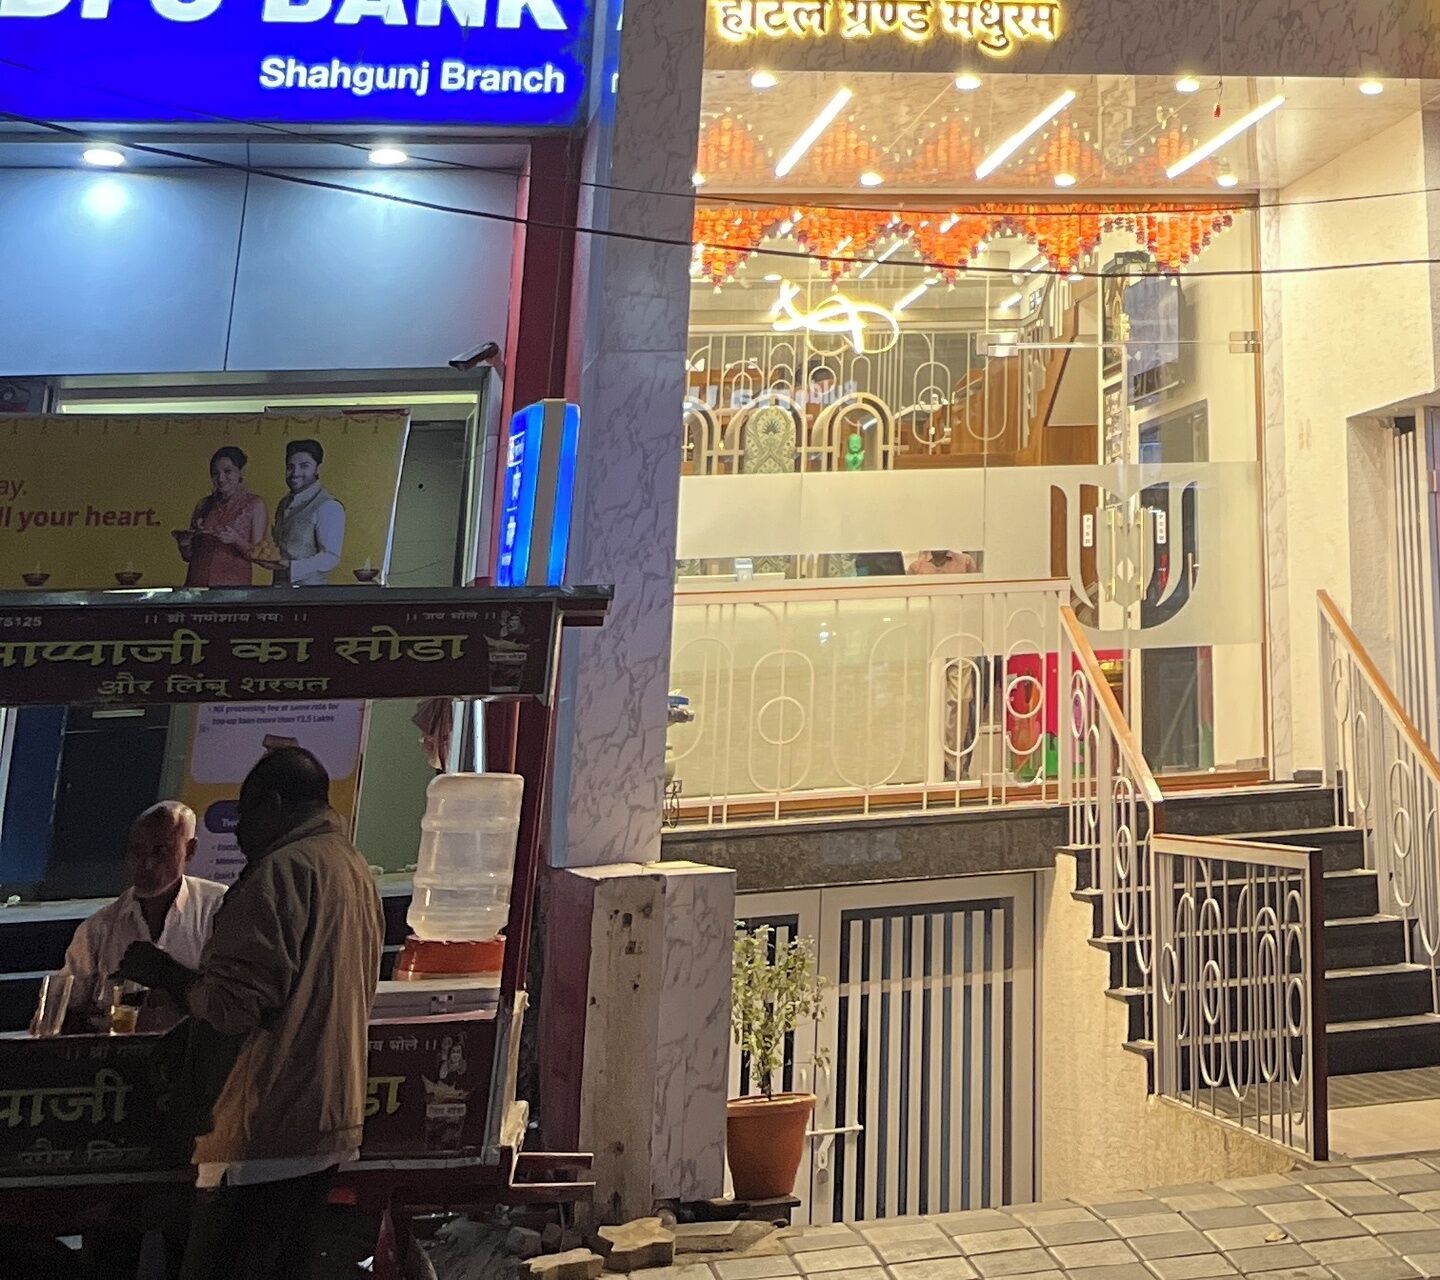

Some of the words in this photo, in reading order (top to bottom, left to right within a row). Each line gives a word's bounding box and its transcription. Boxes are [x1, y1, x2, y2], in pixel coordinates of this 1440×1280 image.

[259, 57, 430, 97] Shahgunj
[440, 61, 566, 94] Branch
[16, 510, 80, 533] your
[85, 505, 161, 526] heart.
[230, 636, 315, 664] का
[333, 625, 470, 665] सोडा
[97, 672, 155, 696] और
[240, 676, 331, 694] शरबत
